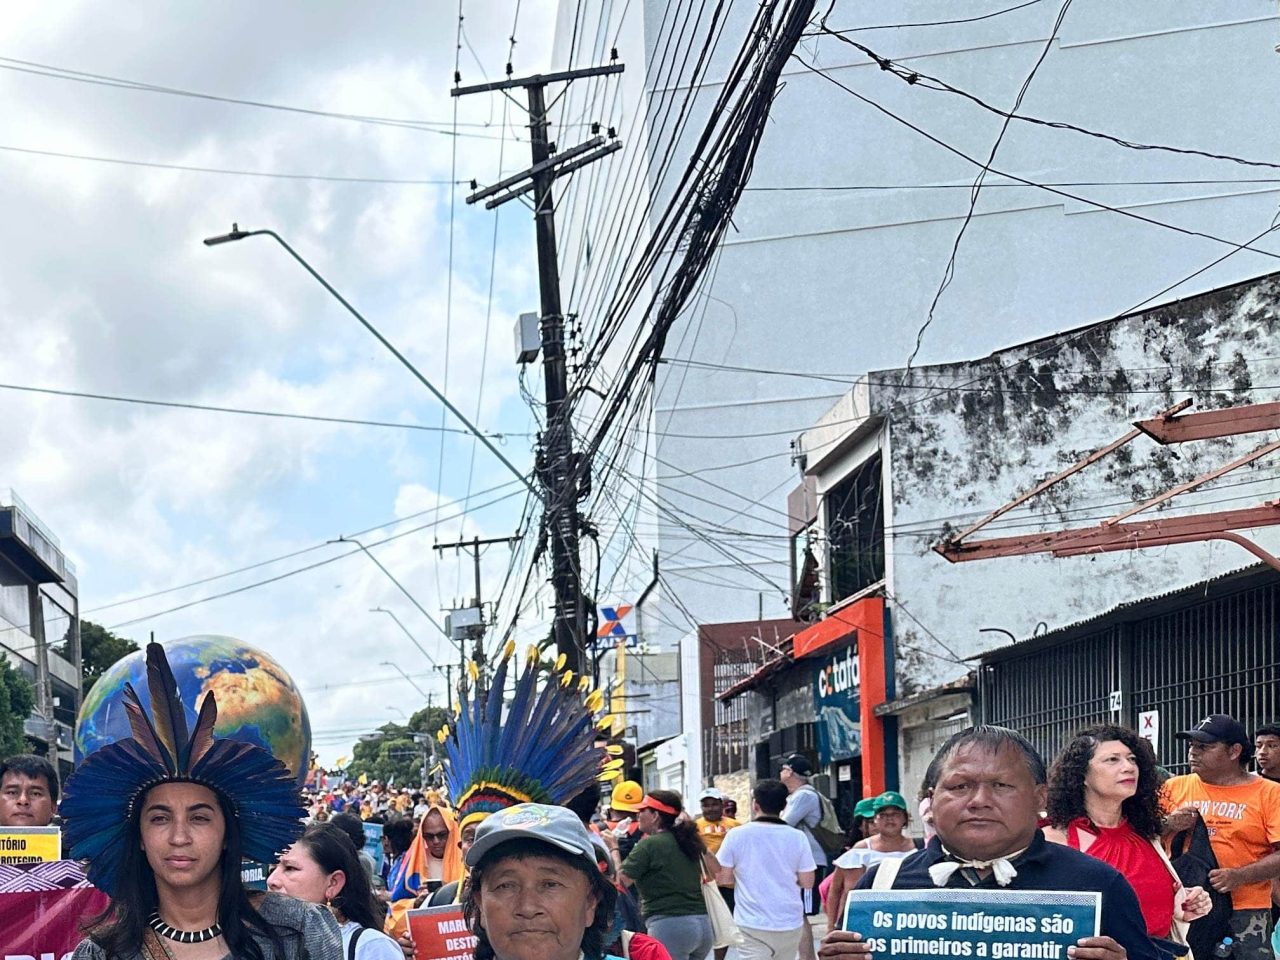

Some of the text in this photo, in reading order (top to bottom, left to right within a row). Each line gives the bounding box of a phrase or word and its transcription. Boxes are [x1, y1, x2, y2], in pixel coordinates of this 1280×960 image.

[1144, 715, 1153, 729] X
[1211, 801, 1246, 819] YORK
[873, 910, 1074, 935] Os povos indígenas são
[867, 937, 886, 952] os
[891, 937, 971, 957] primeiros
[976, 942, 987, 957] a
[992, 939, 1063, 960] garantir
